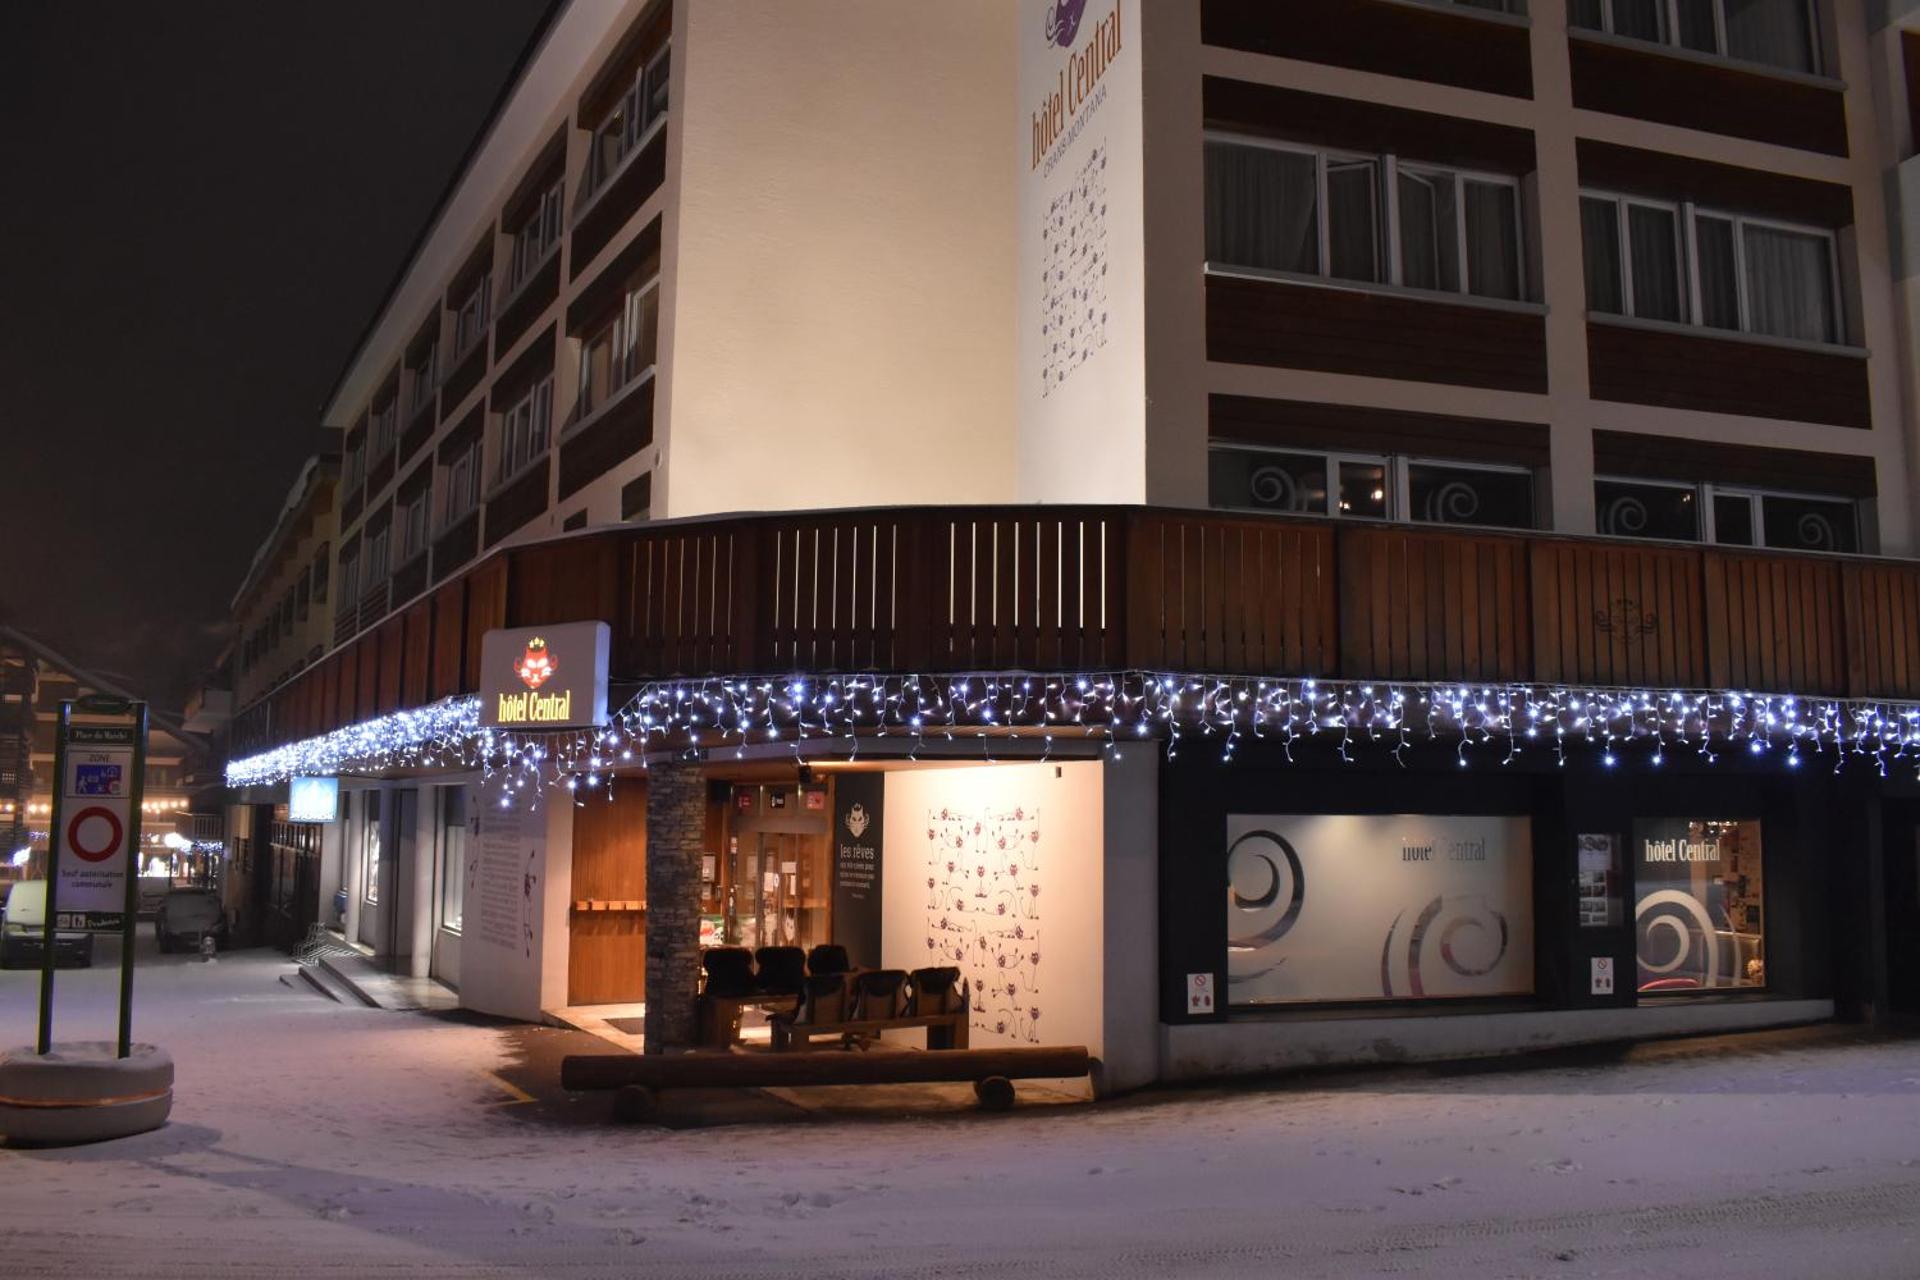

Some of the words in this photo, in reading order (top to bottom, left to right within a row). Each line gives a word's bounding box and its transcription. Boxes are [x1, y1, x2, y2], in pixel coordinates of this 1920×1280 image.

[1031, 69, 1065, 171] hôtel
[1067, 0, 1122, 117] Central
[498, 692, 527, 722] hôtel
[529, 689, 571, 721] Central
[840, 844, 851, 859] les
[853, 843, 875, 860] rêves
[1645, 839, 1676, 862] hôtel
[1678, 839, 1720, 862] Central
